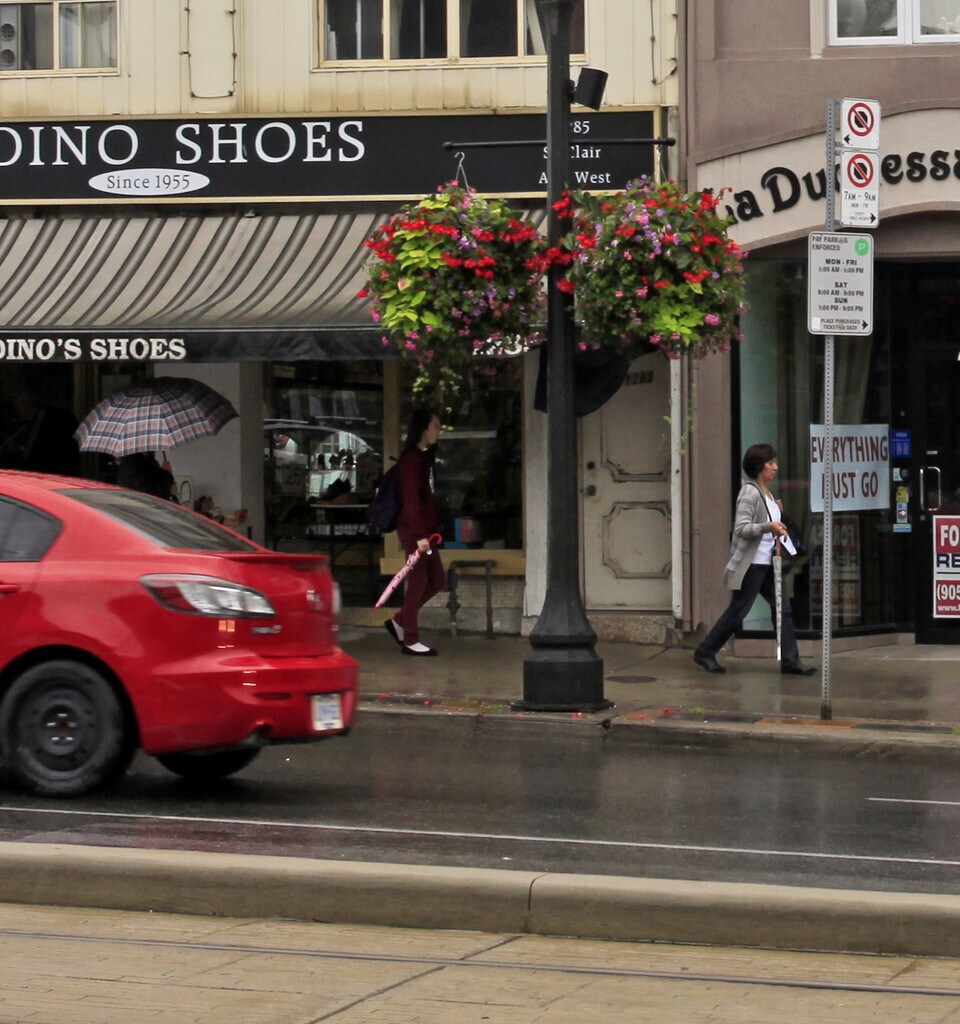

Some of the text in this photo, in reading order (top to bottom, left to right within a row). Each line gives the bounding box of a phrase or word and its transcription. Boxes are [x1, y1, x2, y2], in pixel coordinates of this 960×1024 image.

[175, 121, 365, 164] SHOES
[107, 174, 190, 190] Since 1955
[574, 171, 611, 184] West
[90, 338, 187, 360] SHOES
[811, 436, 888, 463] EVRYTHING
[822, 472, 878, 499] UST GO
